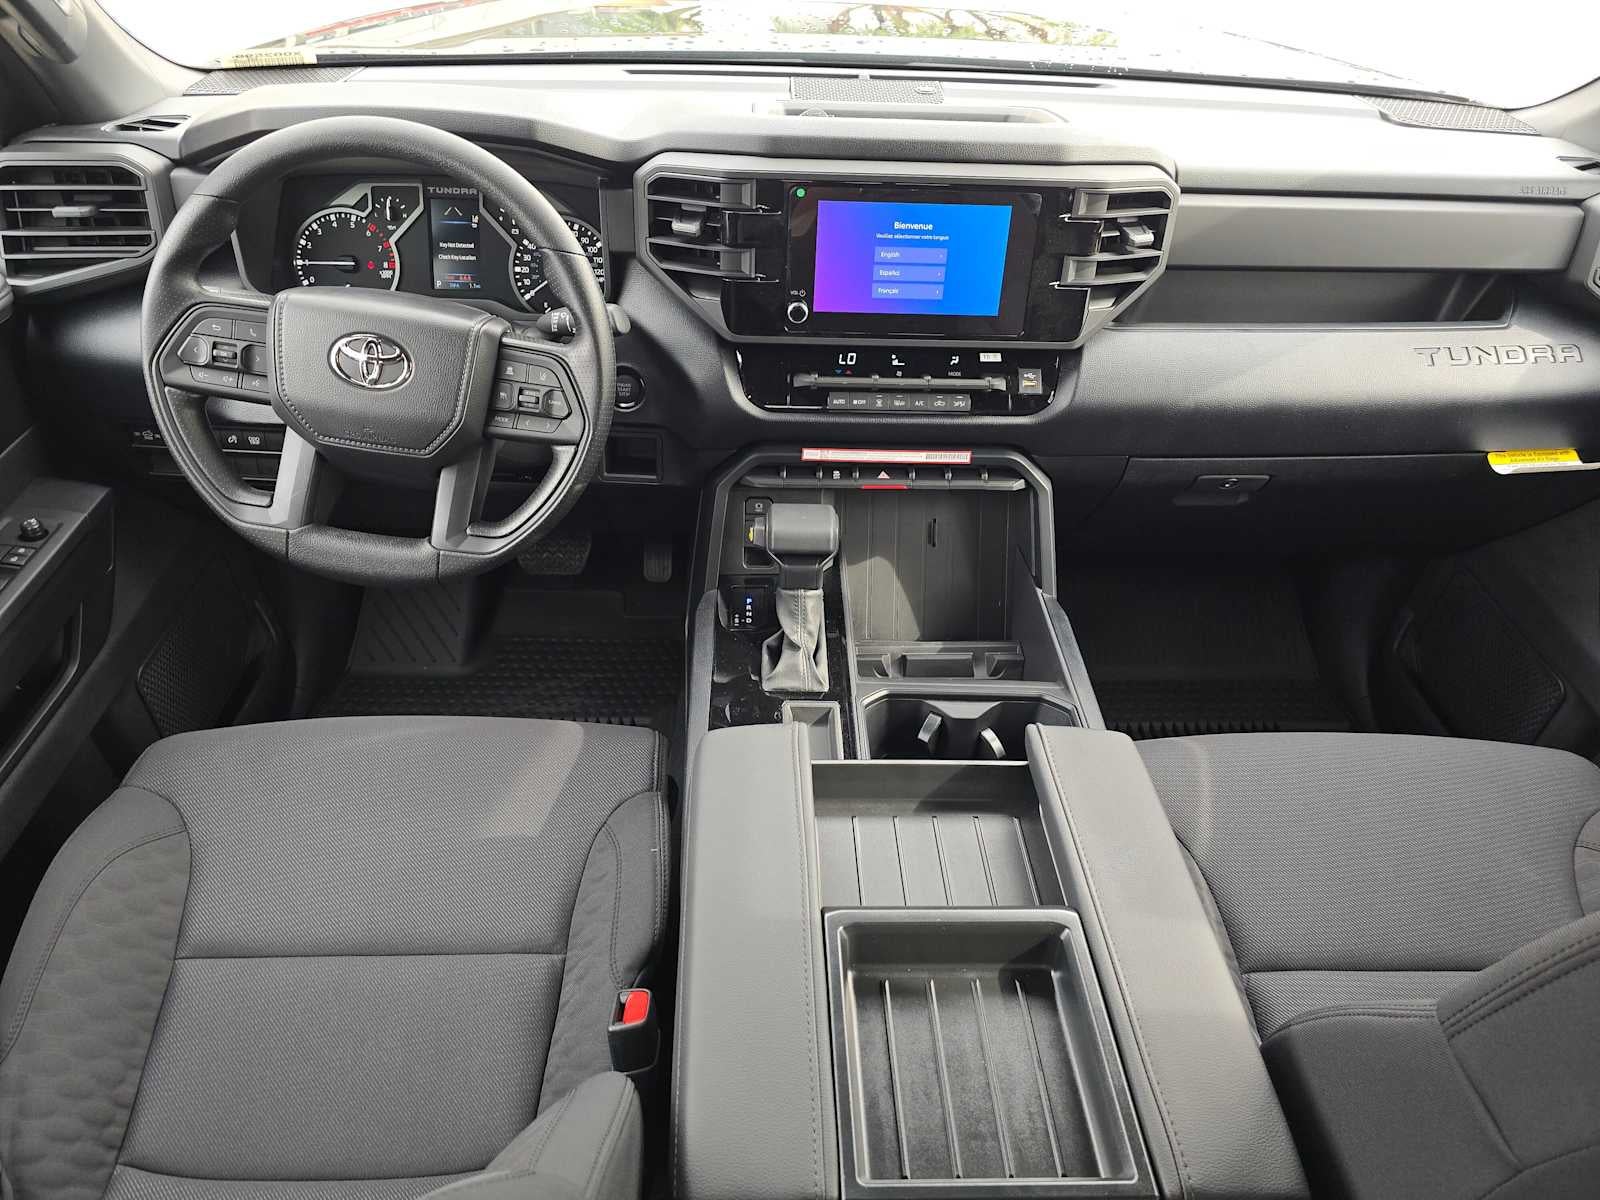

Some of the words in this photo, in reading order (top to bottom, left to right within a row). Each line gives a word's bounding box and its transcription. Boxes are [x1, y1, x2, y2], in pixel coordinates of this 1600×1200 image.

[427, 186, 478, 195] TUNDRA
[893, 220, 934, 231] Bienvenue
[580, 236, 590, 244] 90
[439, 241, 447, 249] Key
[880, 251, 900, 259] English
[592, 256, 603, 264] 110
[593, 268, 605, 276] 120
[879, 269, 900, 277] Español
[436, 280, 442, 288] P
[522, 278, 531, 286] 10
[878, 287, 899, 296] Français
[838, 352, 857, 365] LO
[1413, 343, 1584, 367] TUNDRA
